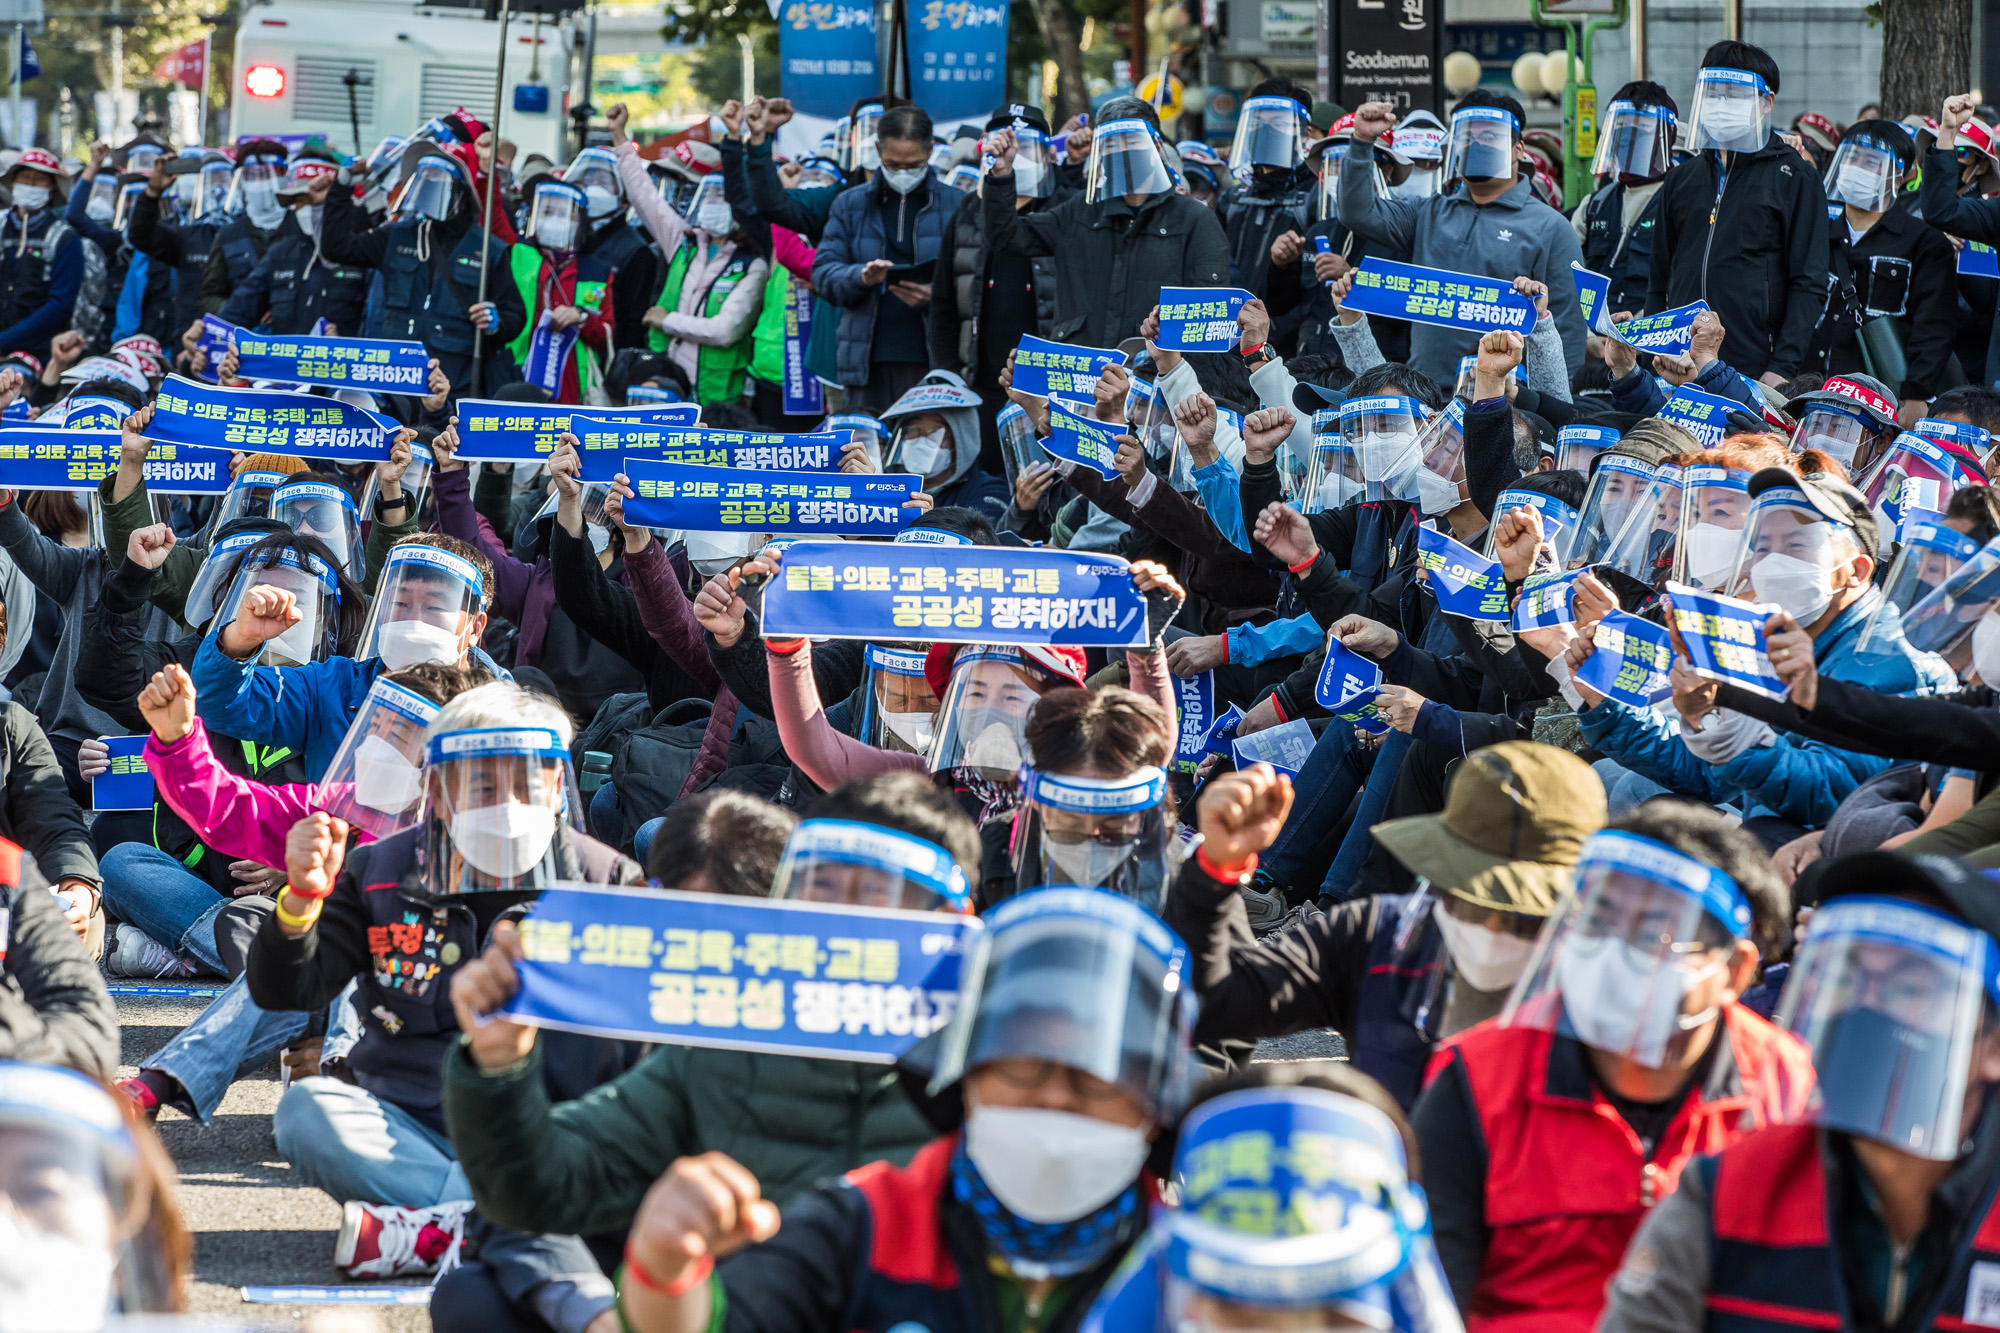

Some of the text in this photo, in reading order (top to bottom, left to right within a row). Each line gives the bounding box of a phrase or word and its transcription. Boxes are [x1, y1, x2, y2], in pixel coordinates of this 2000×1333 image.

[1346, 49, 1430, 69] Seodaemun
[1720, 71, 1744, 80] Shield
[1355, 270, 1500, 303] 돌봄·의료·교육·주택·교통
[1405, 294, 1527, 327] 공공성 쟁취하자!
[1181, 322, 1207, 343] 공공성
[240, 340, 391, 364] 돌봄·의료·교육·주택·교통
[296, 360, 423, 385] 공공성 쟁취하자!
[1046, 370, 1073, 392] 공공성
[156, 392, 344, 425] 돌봄·의료·교육·주택·교통
[1342, 401, 1386, 414] Face Shield
[224, 423, 385, 448] 공공성 쟁취하자!
[1564, 430, 1588, 438] Shield
[1921, 422, 1944, 432] Shield
[584, 432, 785, 450] 돌봄·의료·교육·주택·교통
[1076, 435, 1098, 460] 공공성
[1904, 436, 1930, 453] Shield
[733, 445, 829, 470] 쟁취하자!
[1605, 456, 1627, 465] Face
[253, 474, 275, 483] Face
[638, 479, 906, 499] 돌봄·의료·교육·주택·교통 민주노총
[281, 486, 334, 497] Face Shield
[1505, 494, 1532, 503] Shield
[719, 501, 899, 524] 공공성 쟁취하자!
[233, 537, 256, 545] Face
[914, 531, 945, 543] Shield
[401, 550, 465, 572] Face Shield
[786, 565, 1129, 595] 돌봄·의료·교육·주택·교통 민주노총
[892, 595, 1117, 630] 공공성 쟁취하자!
[882, 655, 907, 667] Face
[1613, 661, 1649, 694] 공공성
[389, 692, 425, 716] Shield
[455, 736, 487, 749] Face
[1054, 789, 1135, 805] Face Shield
[367, 922, 424, 957] 투쟁
[648, 972, 786, 1031] 공공성
